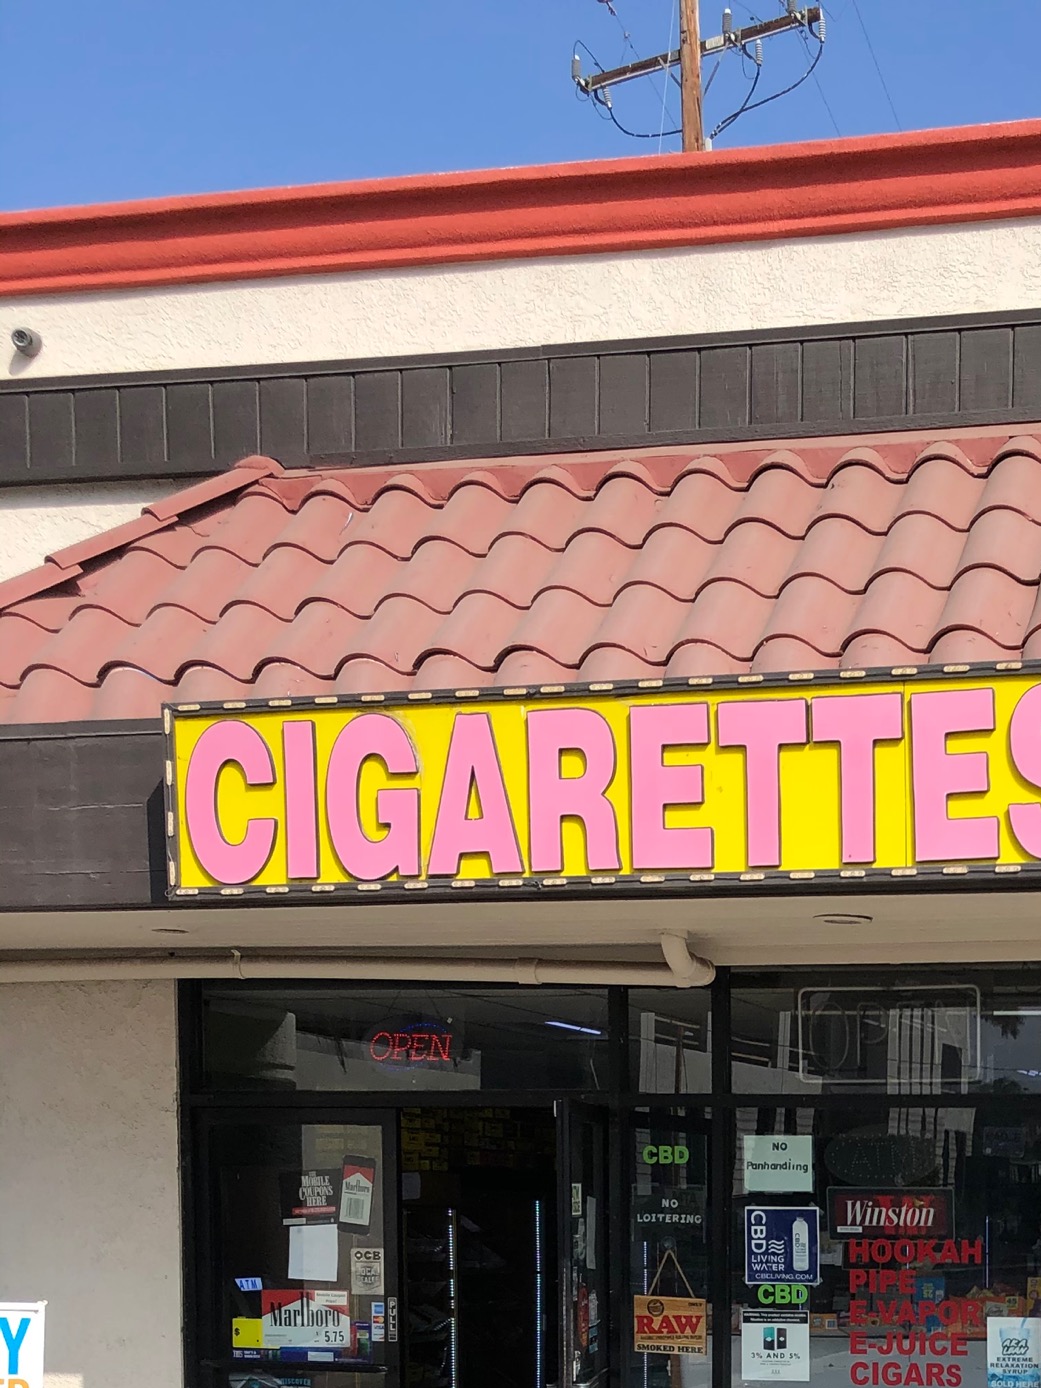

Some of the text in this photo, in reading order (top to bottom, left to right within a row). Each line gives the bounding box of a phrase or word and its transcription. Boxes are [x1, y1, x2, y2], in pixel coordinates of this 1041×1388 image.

[369, 1031, 453, 1061] OPEN
[642, 1145, 690, 1165] CBD
[772, 1142, 788, 1151] NO
[299, 1186, 333, 1200] COUPONS
[306, 1196, 328, 1207] HERE
[661, 1198, 679, 1208] NO
[636, 1213, 703, 1224] LOITERING
[846, 1200, 935, 1227] Winston
[750, 1210, 767, 1254] CBD
[354, 1251, 381, 1260] OCB
[751, 1254, 785, 1263] LIVING
[849, 1238, 982, 1265] HOOKAH
[751, 1263, 785, 1272] WATER
[239, 1279, 258, 1289] ATM
[849, 1269, 917, 1294] PIPE
[757, 1284, 808, 1305] CBD
[271, 1288, 341, 1327] Marlboro
[388, 1300, 396, 1331] PULL
[849, 1299, 981, 1326] E-VAPOR
[635, 1315, 703, 1335] RAW
[324, 1331, 345, 1343] 5.75
[848, 1331, 969, 1356] E-JUICE
[637, 1343, 704, 1354] SMOKED HERE
[766, 1352, 785, 1360] AND
[789, 1352, 801, 1360] 5%
[850, 1362, 963, 1387] CIGARS
[991, 1380, 1040, 1388] SOLD HERE
